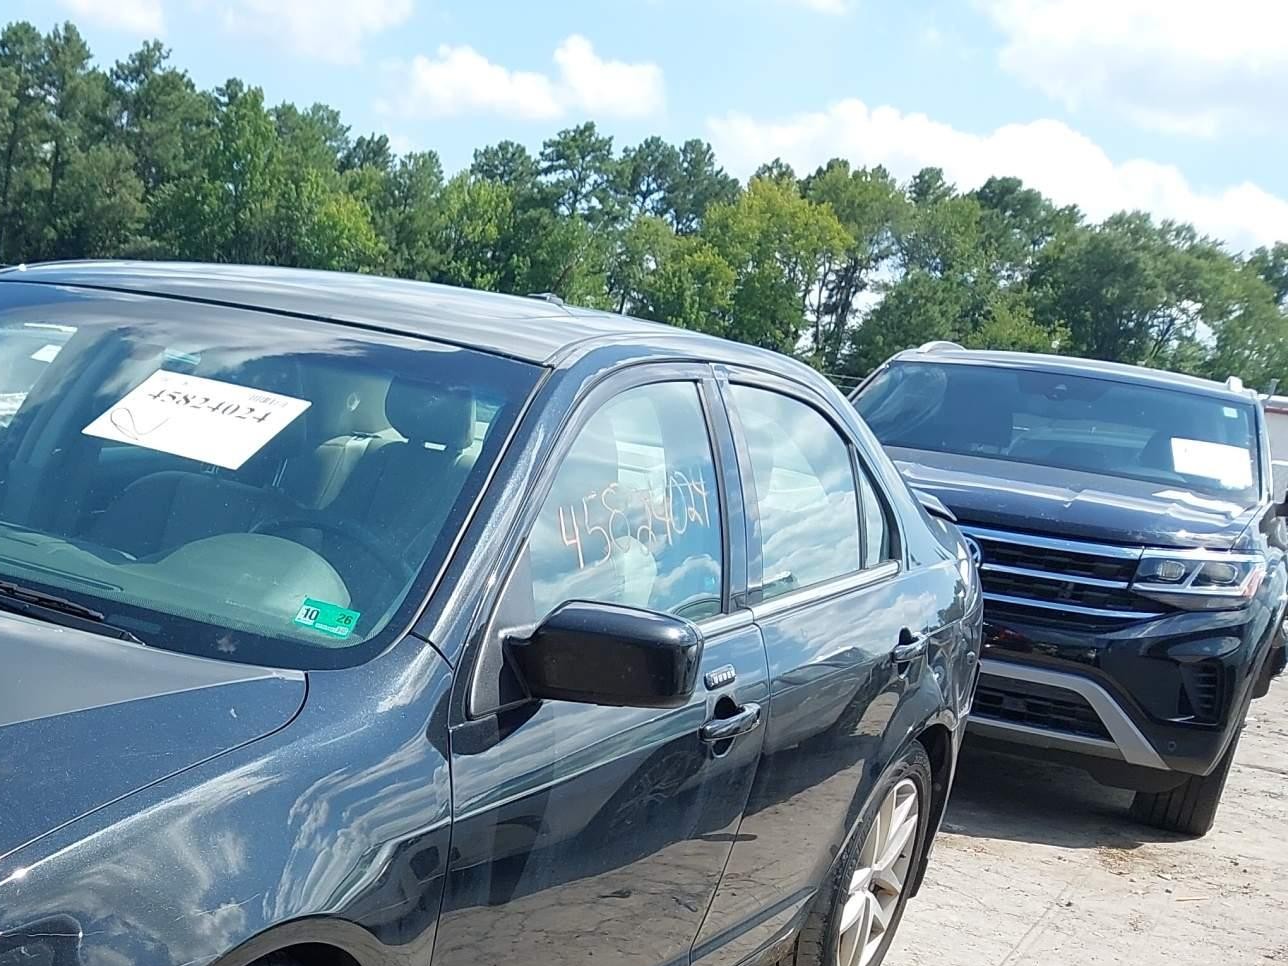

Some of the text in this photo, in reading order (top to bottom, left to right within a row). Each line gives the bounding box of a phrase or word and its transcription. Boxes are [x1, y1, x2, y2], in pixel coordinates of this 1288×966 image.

[148, 388, 271, 424] 45824024
[303, 607, 353, 625] 10 26
